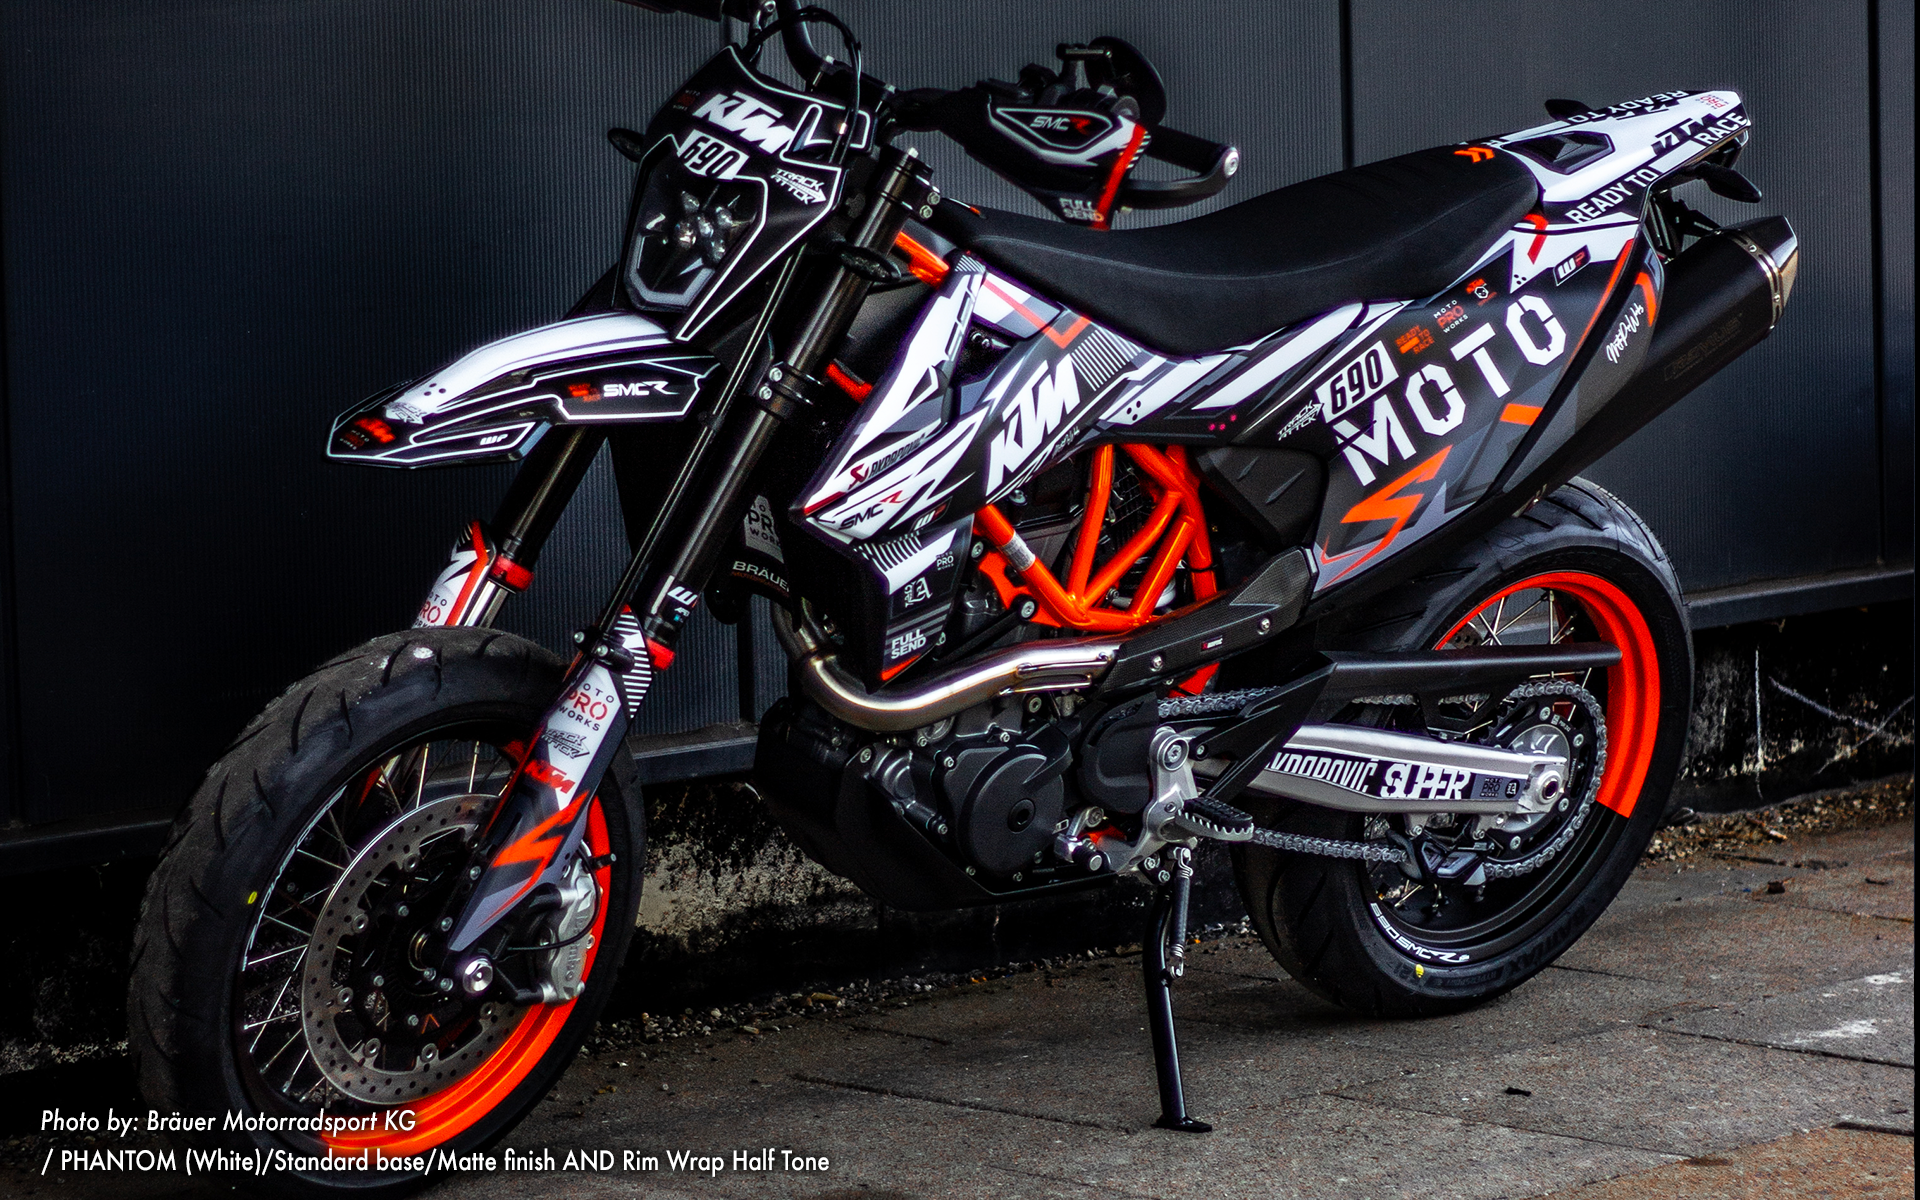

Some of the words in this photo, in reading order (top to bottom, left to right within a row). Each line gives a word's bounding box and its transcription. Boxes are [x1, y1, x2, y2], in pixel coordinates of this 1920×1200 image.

[692, 90, 794, 154] KTM
[1694, 111, 1748, 148] RACE
[684, 135, 741, 178] 690
[1565, 182, 1633, 224] READY
[1625, 169, 1659, 188] TO
[1433, 299, 1458, 319] MOTO
[1437, 305, 1465, 329] PRO
[1443, 314, 1468, 333] WORKS
[1330, 349, 1384, 416] 690
[1332, 294, 1567, 487] MOTO
[986, 353, 1080, 497] KTM
[748, 510, 774, 535] PR
[937, 555, 954, 567] PRO
[421, 601, 441, 624] RO
[891, 629, 924, 650] FULL
[891, 637, 927, 659] SEND
[582, 683, 614, 703] OTO
[558, 706, 601, 731] WORKS
[1482, 783, 1500, 792] PRO
